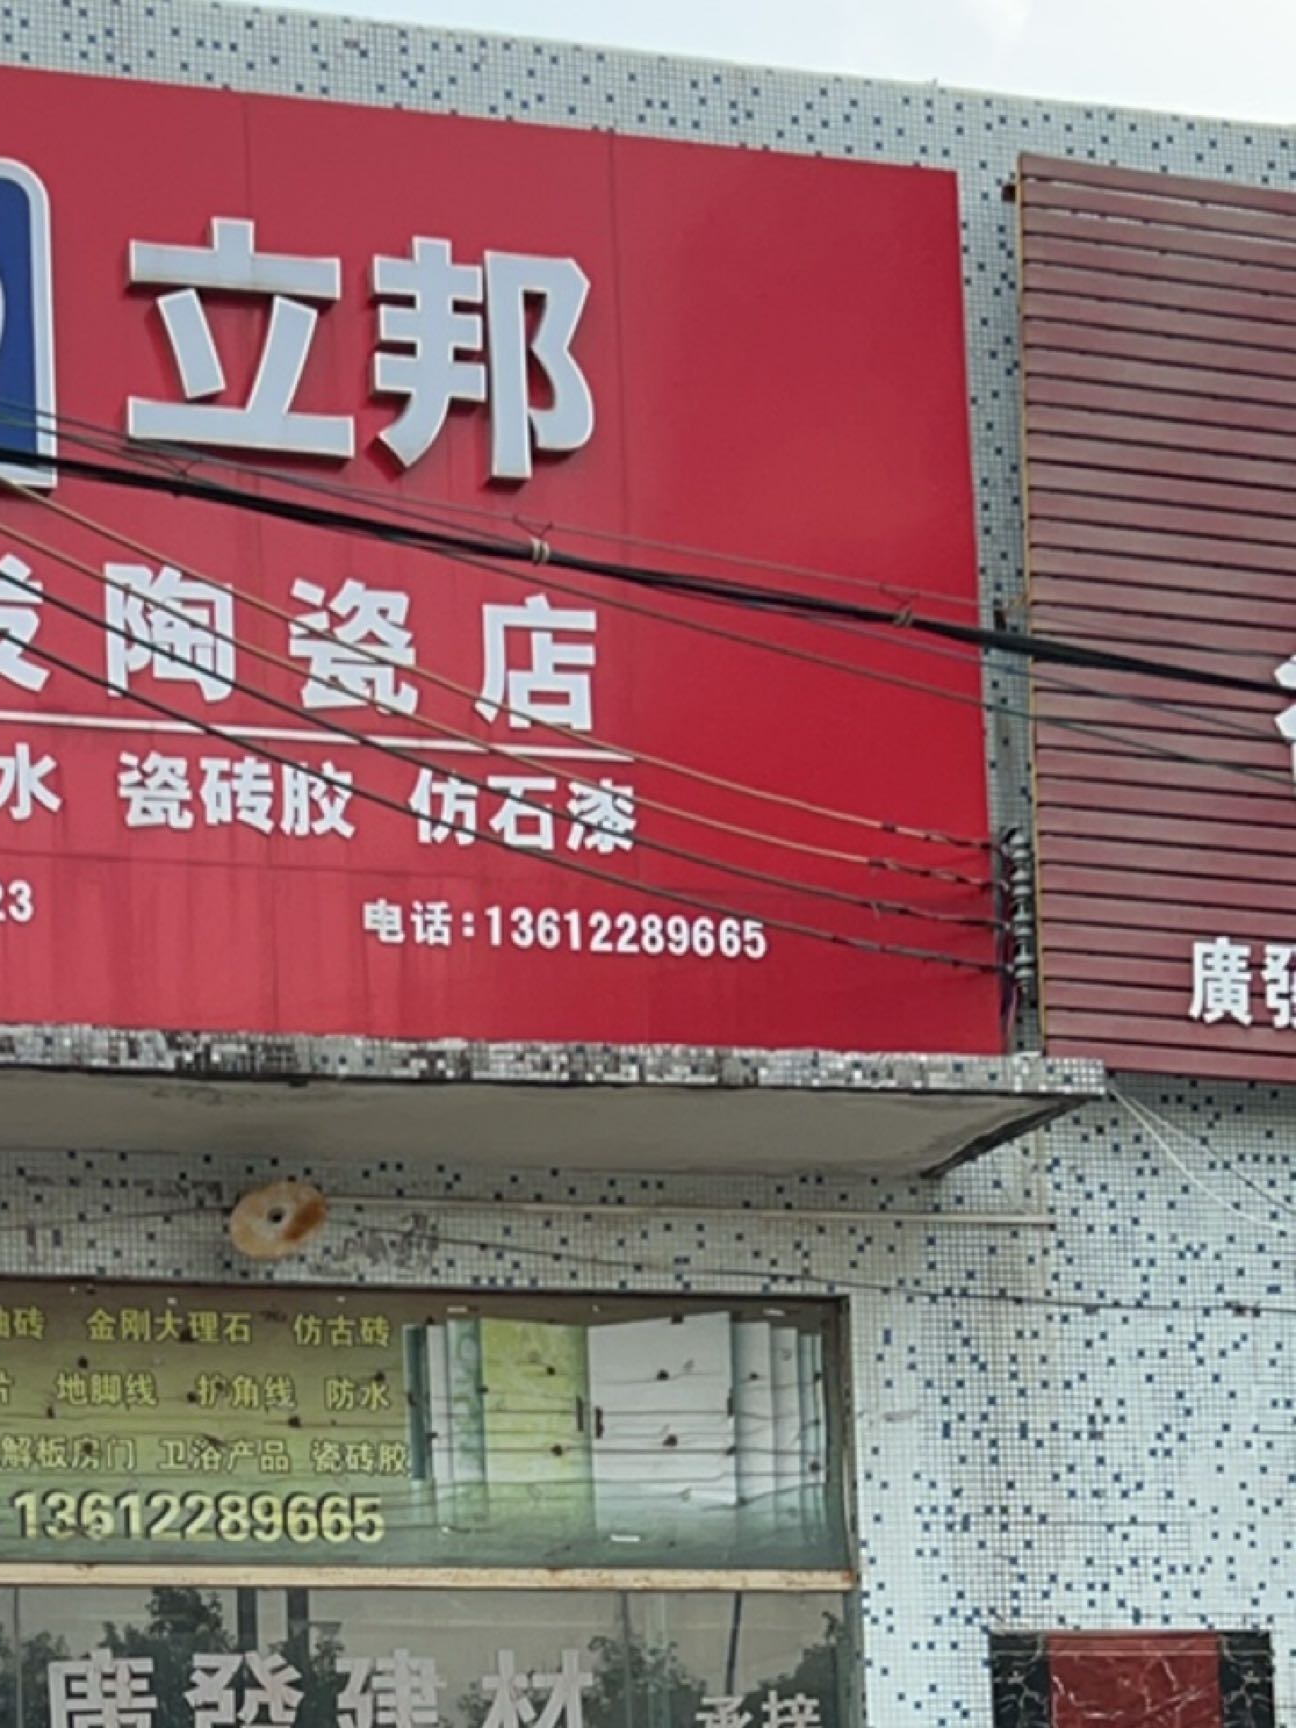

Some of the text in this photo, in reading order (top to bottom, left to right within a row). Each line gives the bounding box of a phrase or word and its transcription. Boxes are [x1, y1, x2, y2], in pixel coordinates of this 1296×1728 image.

[126, 215, 595, 482] 立邦
[117, 751, 356, 841] 瓷砖胶
[408, 767, 639, 855] 仿石漆
[84, 1308, 253, 1344] 金刚大理石
[292, 1314, 392, 1348] 仿古砖
[56, 1372, 159, 1406] 地脚线
[323, 1376, 392, 1411] 防水
[157, 1438, 294, 1475] 卫浴产品
